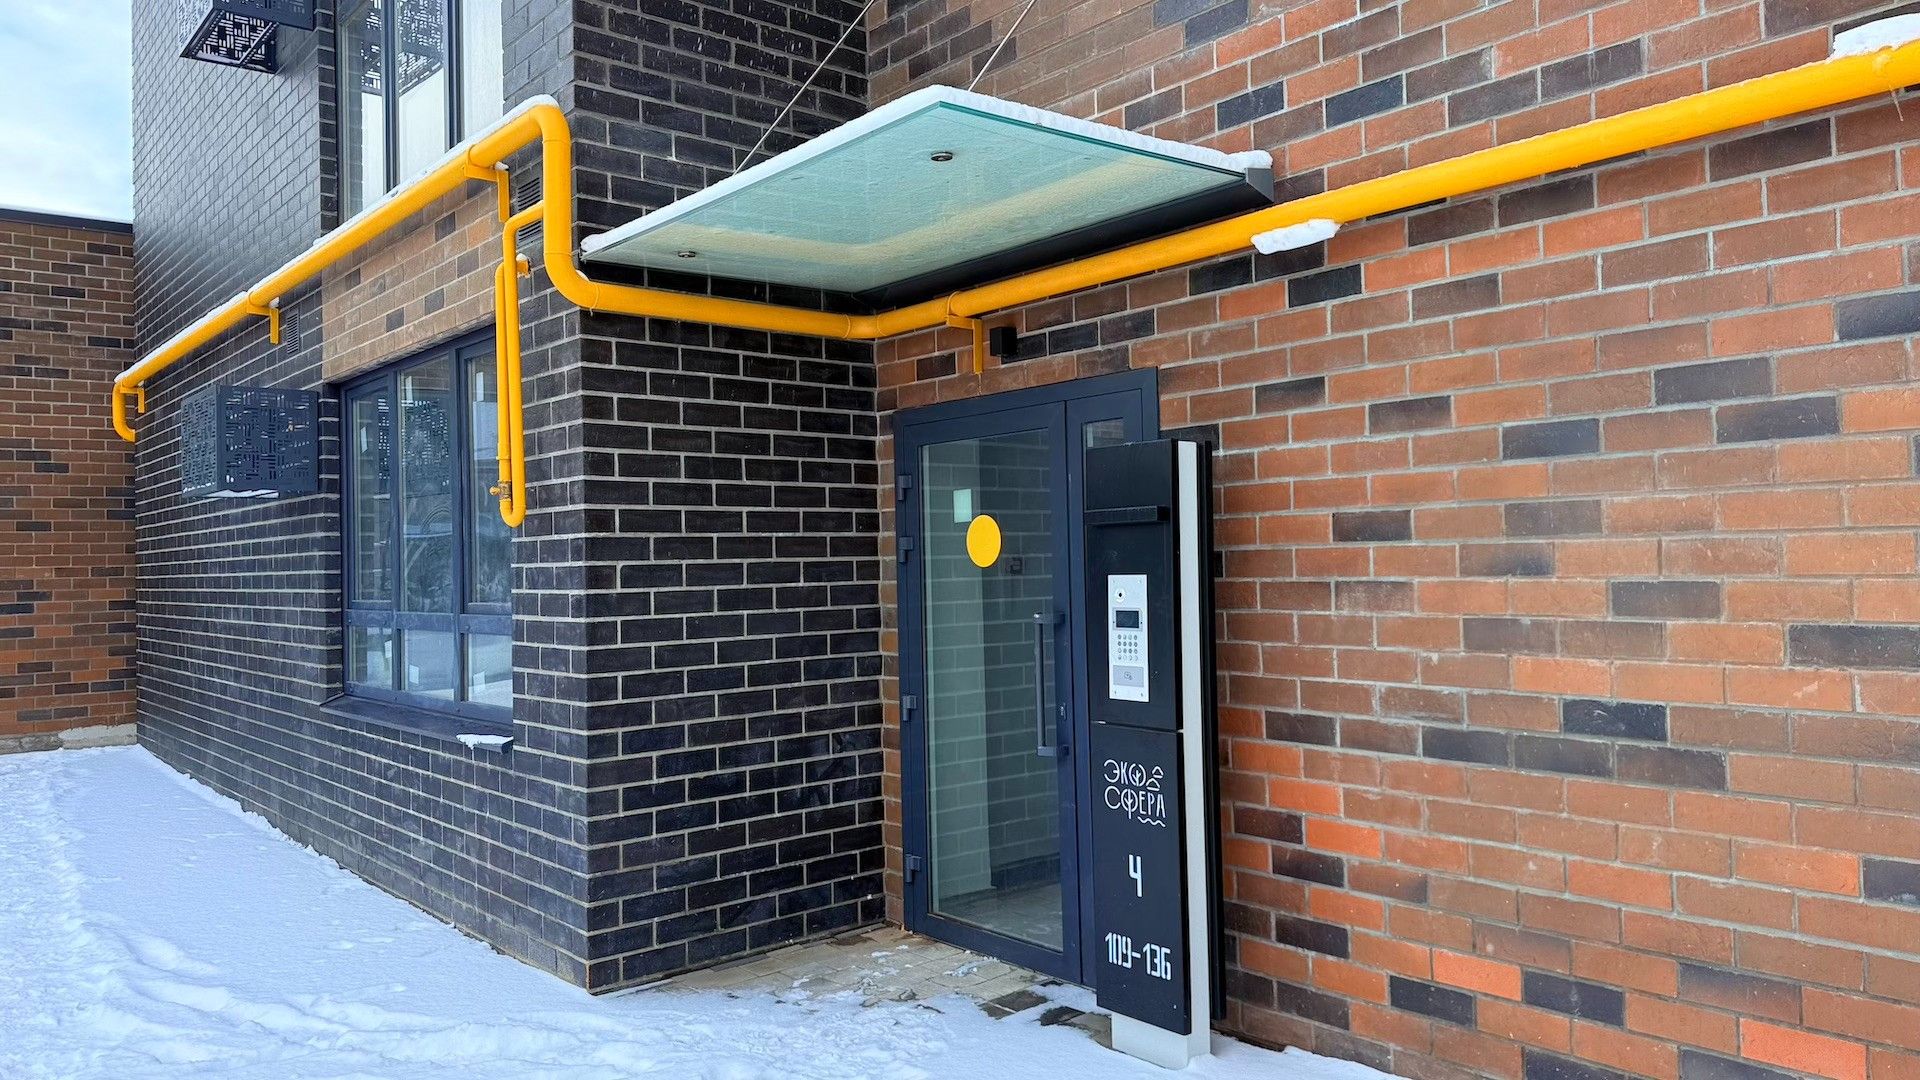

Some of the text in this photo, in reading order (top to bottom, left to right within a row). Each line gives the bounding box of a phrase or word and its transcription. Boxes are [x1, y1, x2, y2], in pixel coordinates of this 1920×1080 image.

[1103, 759, 1146, 787] ЭКО
[1104, 785, 1166, 819] СФЕРА
[1128, 854, 1142, 898] 4
[1104, 932, 1172, 981] 109-136
